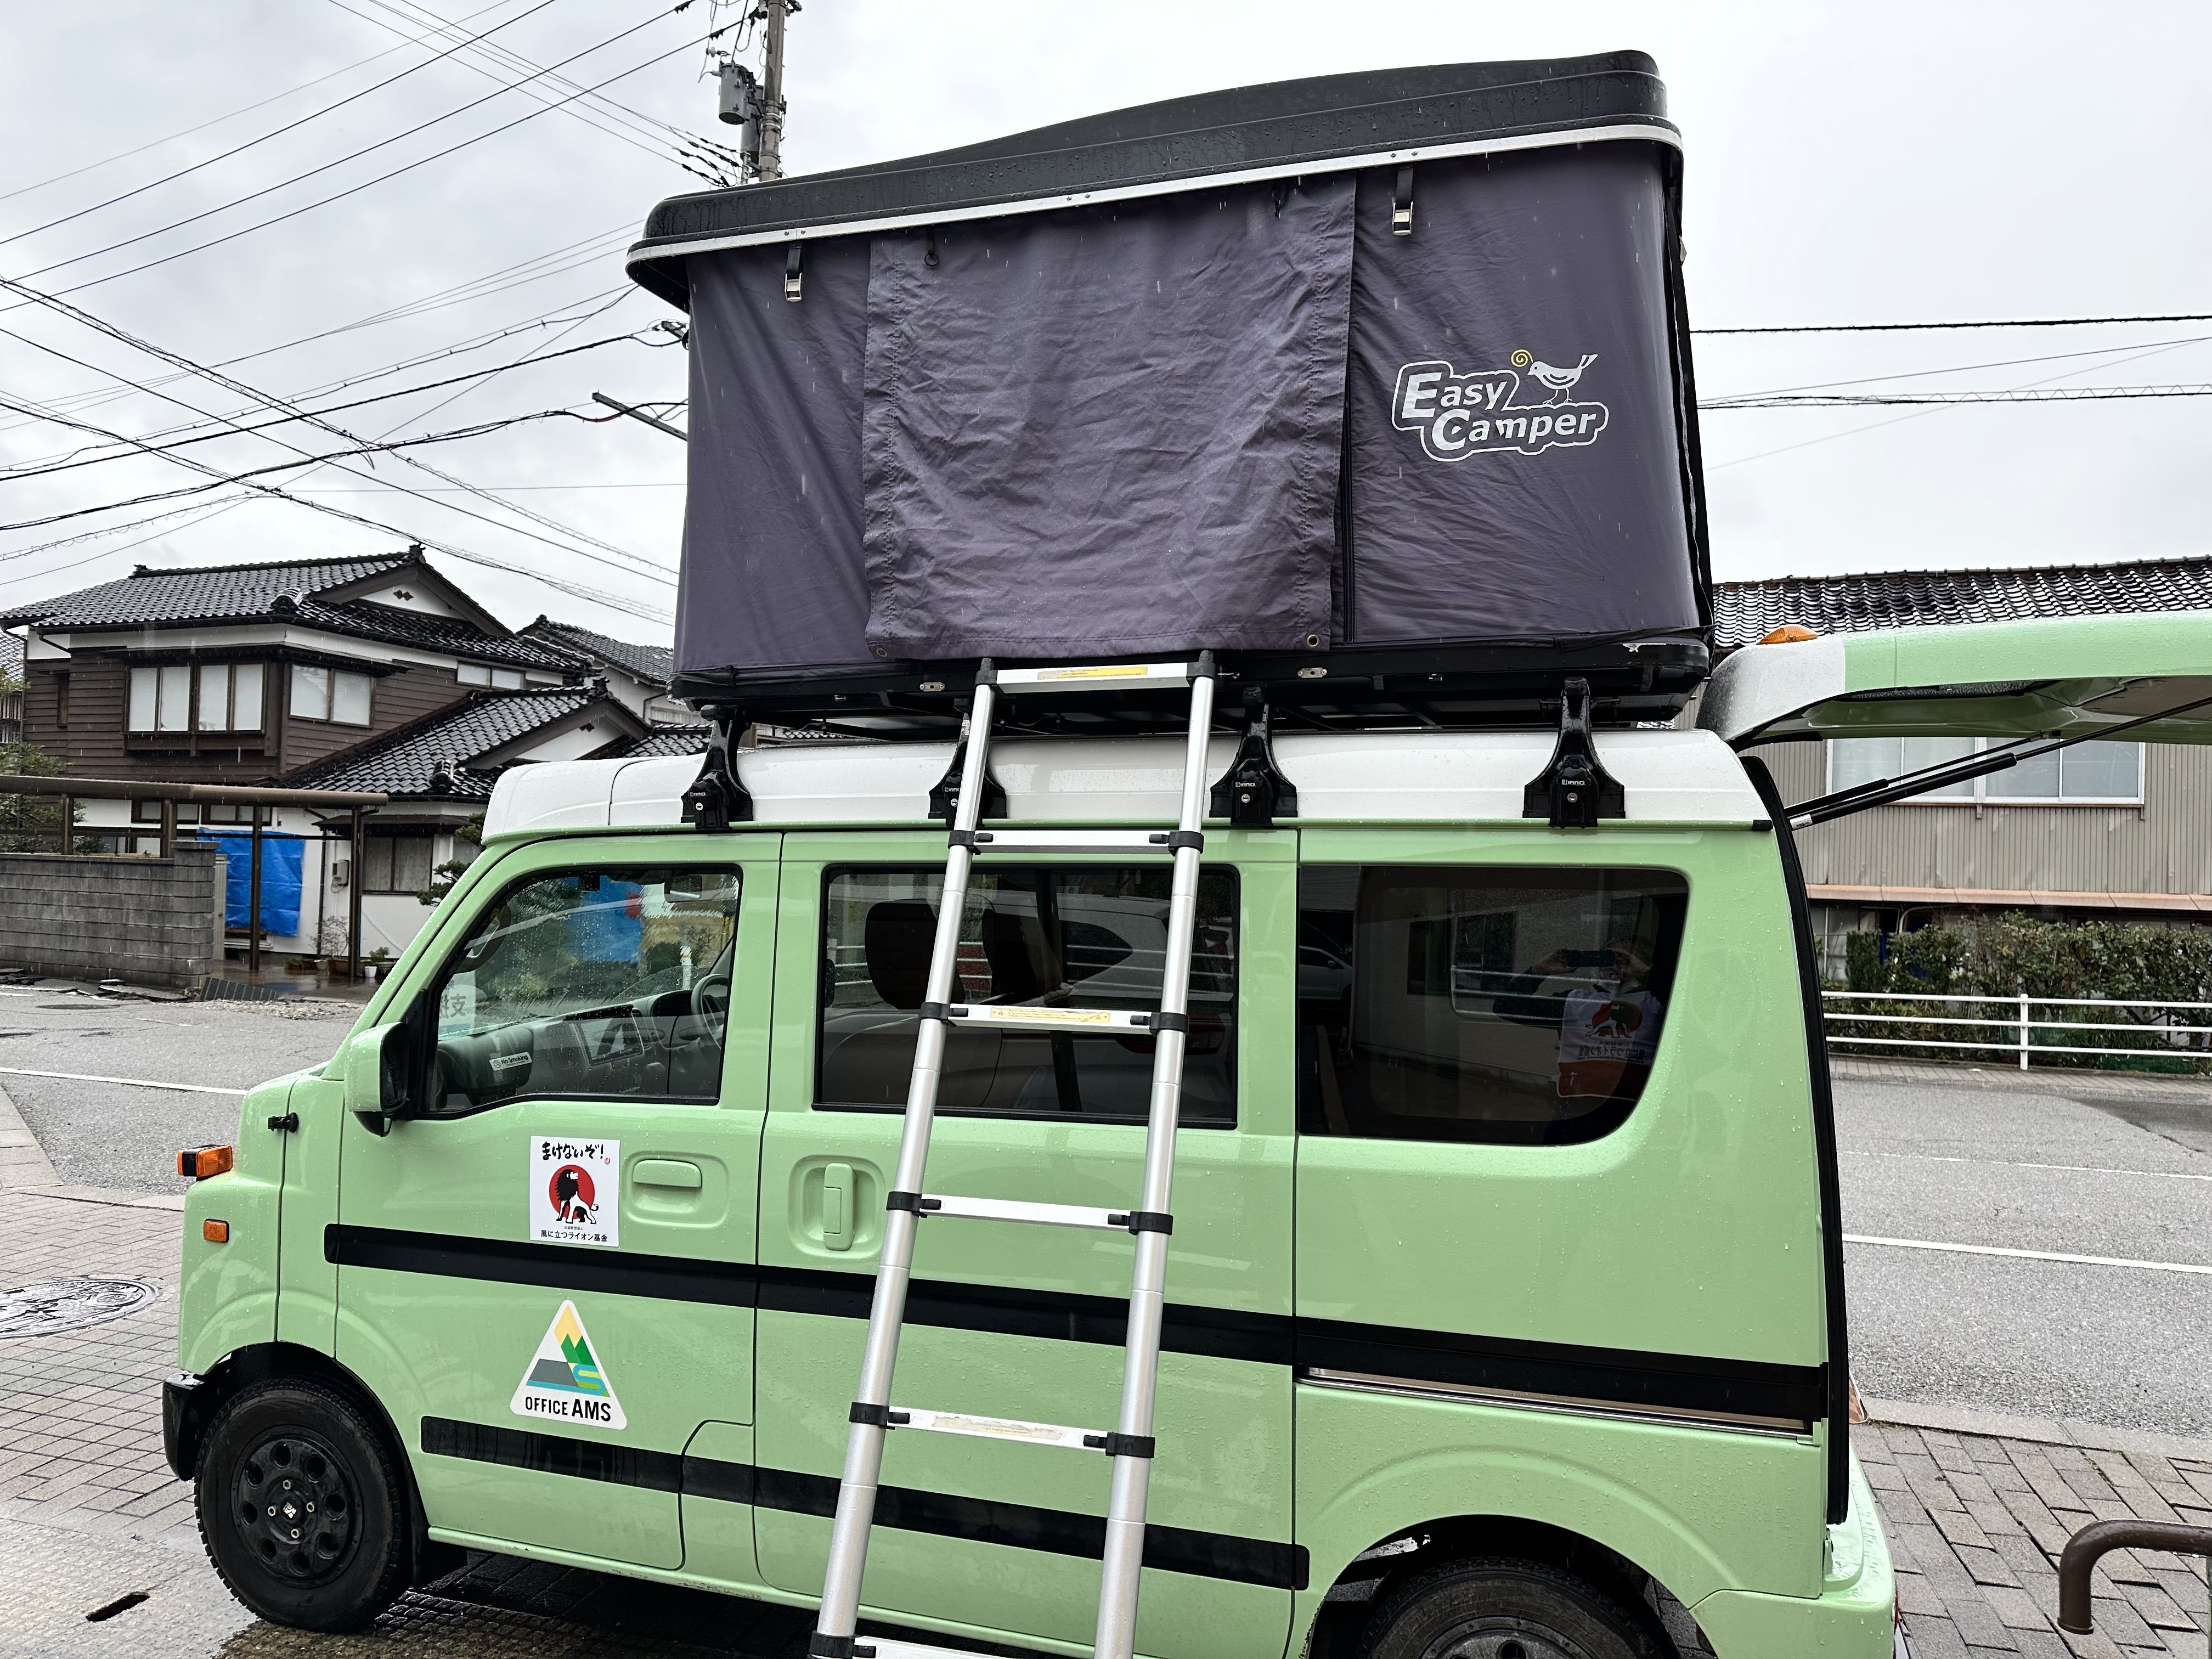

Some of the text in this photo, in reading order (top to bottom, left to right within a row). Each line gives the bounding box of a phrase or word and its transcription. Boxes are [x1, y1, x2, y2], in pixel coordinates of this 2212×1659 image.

[1402, 372, 1508, 419] Easy
[1432, 408, 1596, 451] Camper
[541, 1229, 608, 1242] 風に立つライオン基金
[525, 1396, 611, 1422] OFFICE AMS
